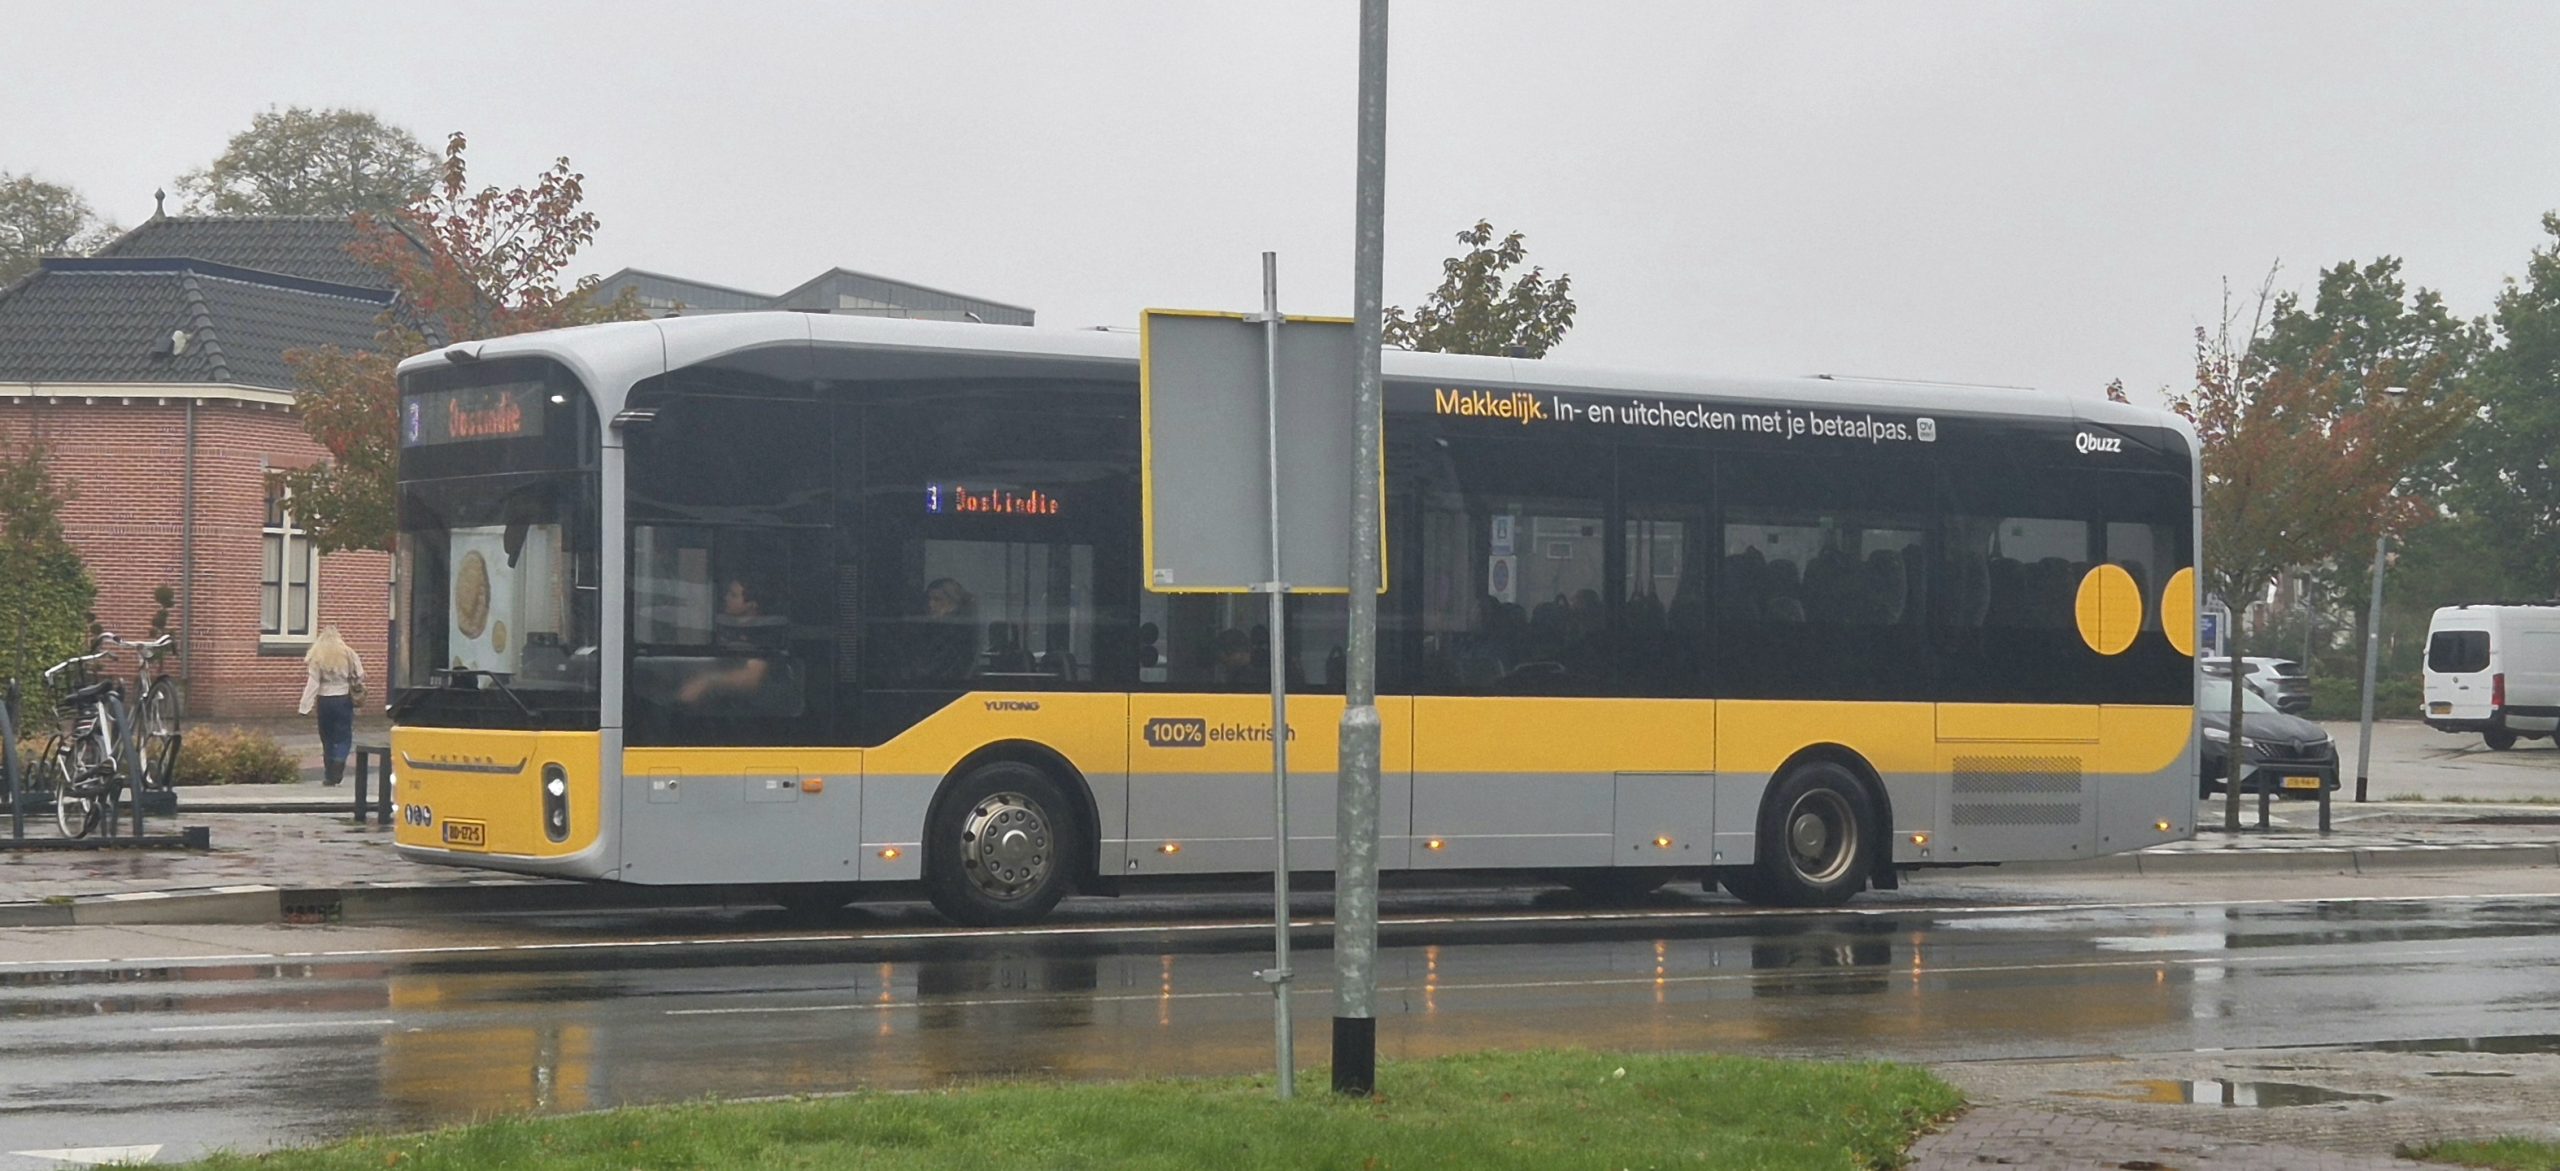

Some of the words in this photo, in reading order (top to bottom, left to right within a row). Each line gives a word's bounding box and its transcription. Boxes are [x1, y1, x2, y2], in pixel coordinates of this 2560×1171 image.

[408, 402, 419, 442] 3
[1435, 388, 1548, 425] Makkelijk.
[1553, 396, 1582, 421] In-
[1588, 404, 1615, 424] en
[1621, 400, 1735, 430] uitchecken
[1742, 411, 1782, 433] met
[1786, 410, 1805, 440] je
[1810, 411, 1912, 444] betaalpas.
[2076, 432, 2122, 454] Qbuzz
[984, 701, 1040, 711] YUTONG
[1152, 723, 1202, 742] 100%
[1209, 723, 1296, 741] elektrish
